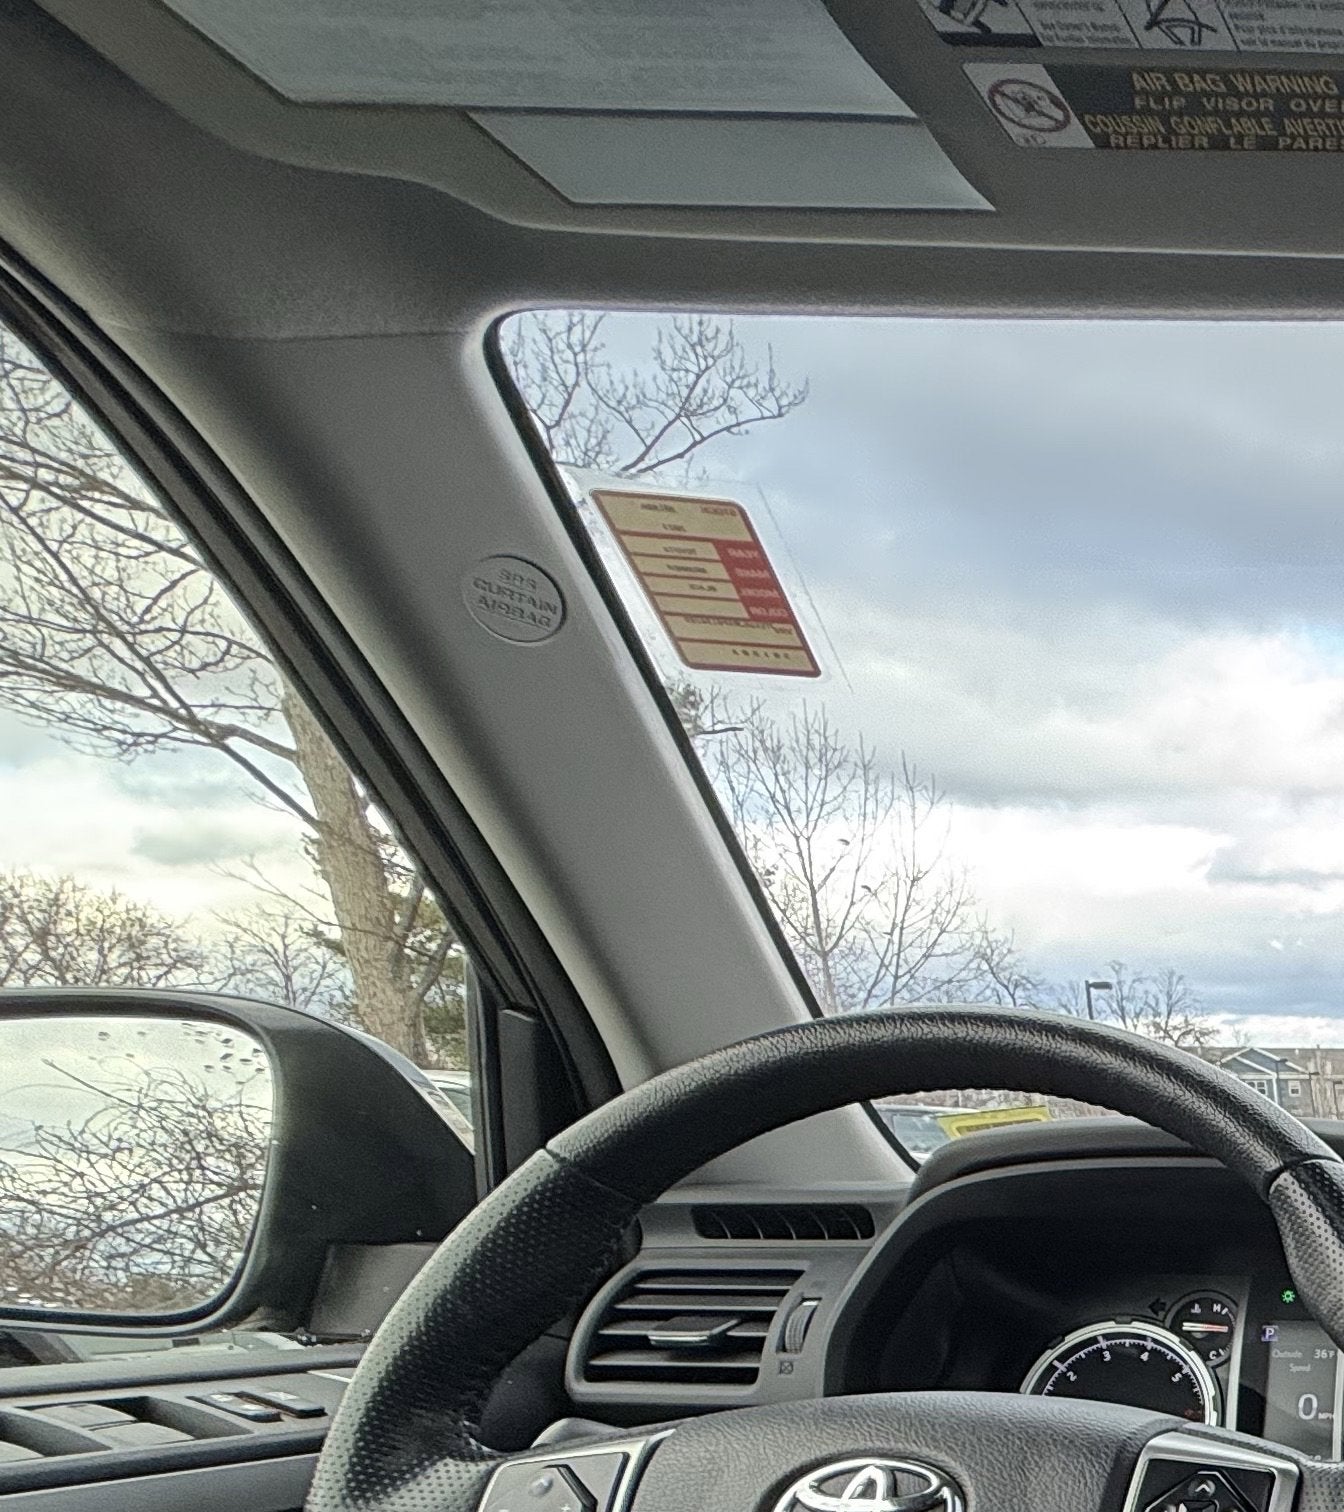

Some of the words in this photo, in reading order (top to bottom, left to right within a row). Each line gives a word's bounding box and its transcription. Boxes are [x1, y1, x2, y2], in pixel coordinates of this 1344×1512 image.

[1132, 72, 1170, 91] AIR
[1174, 73, 1226, 93] BAG
[1231, 75, 1338, 95] WARNING
[1134, 97, 1184, 110] FLIP
[1204, 98, 1274, 111] VISOR
[1085, 115, 1164, 134] COUSSIN
[1170, 116, 1279, 136] GONFLABLE
[1110, 135, 1208, 148] REPLIER
[1231, 137, 1256, 149] LE
[473, 577, 557, 615] CURTAIN
[478, 596, 551, 628] AIRBAG
[1265, 1327, 1275, 1339] P
[1102, 1351, 1111, 1362] 3
[1140, 1351, 1150, 1362] 4
[1066, 1370, 1078, 1382] 2
[1171, 1371, 1183, 1383] 5
[1298, 1393, 1319, 1421] 0
